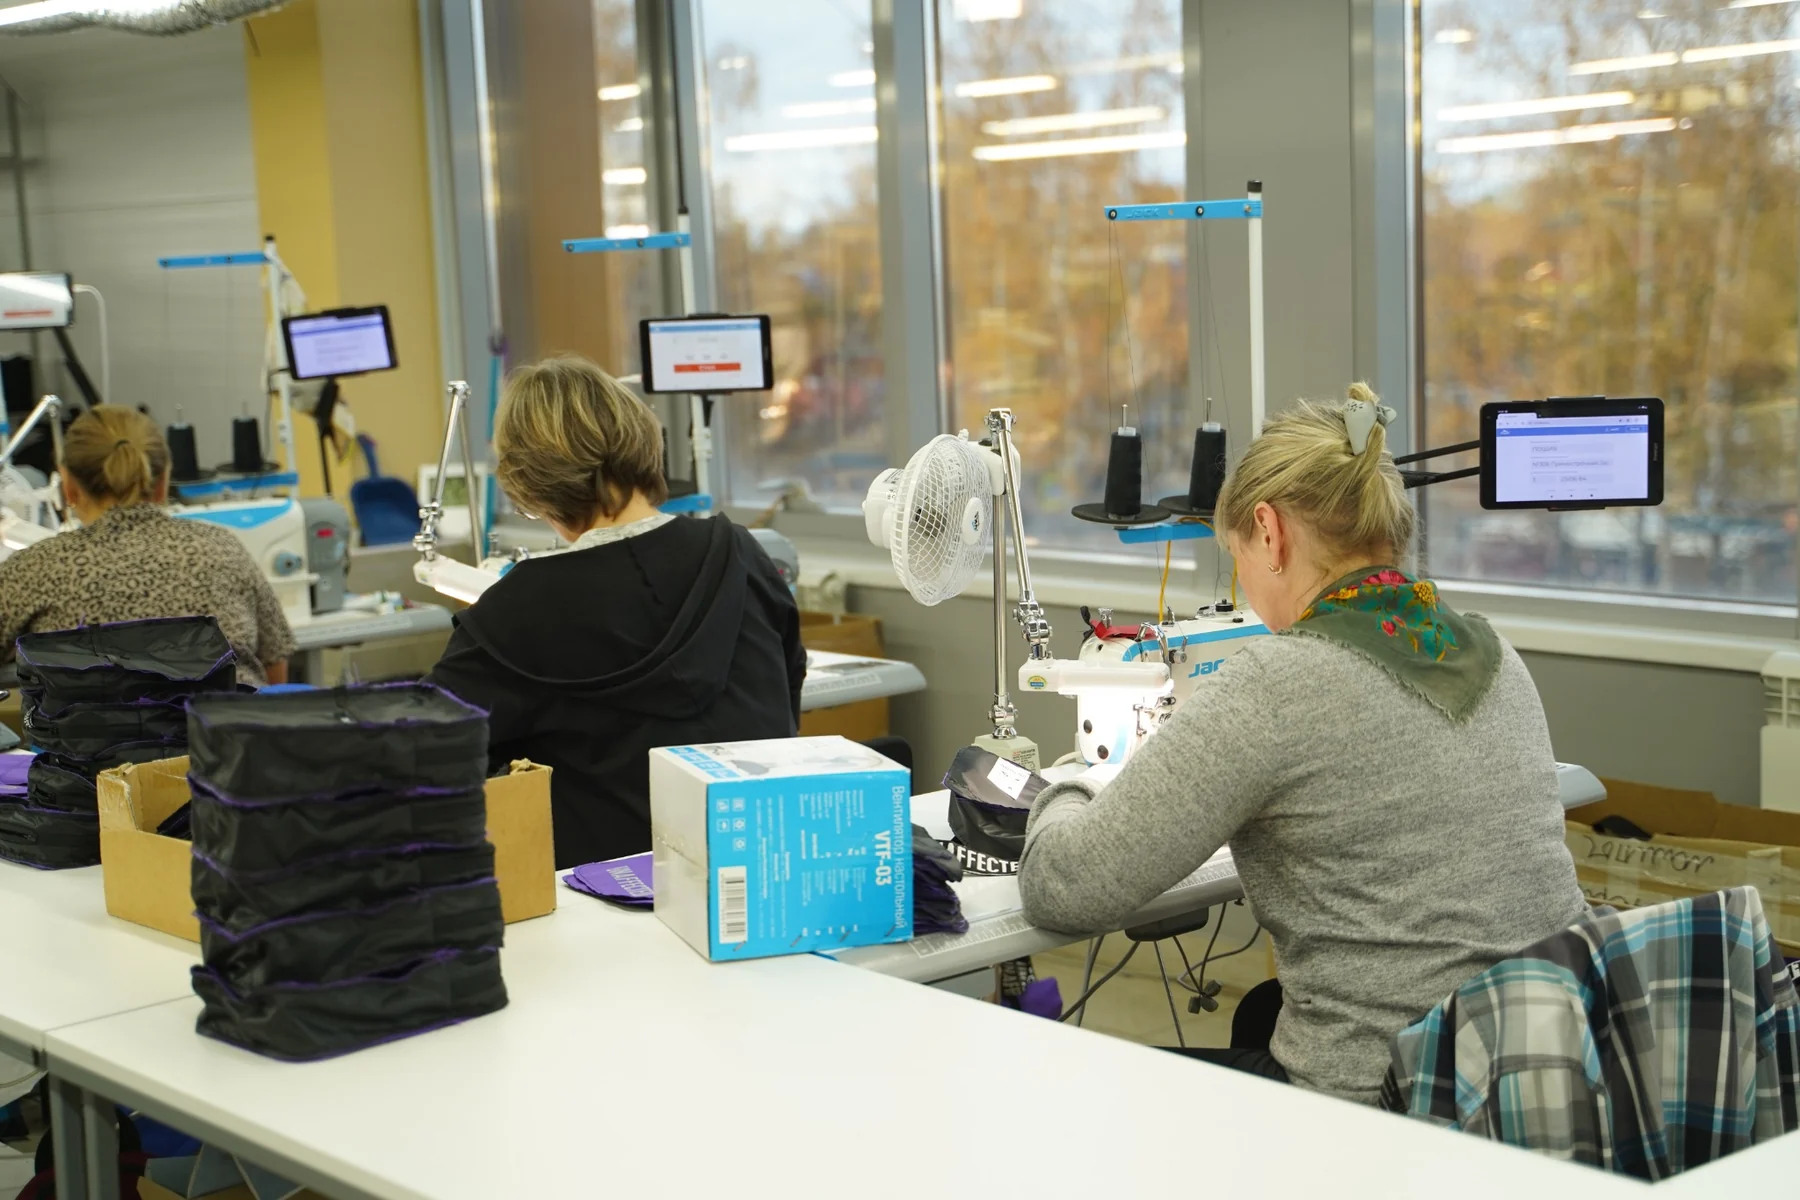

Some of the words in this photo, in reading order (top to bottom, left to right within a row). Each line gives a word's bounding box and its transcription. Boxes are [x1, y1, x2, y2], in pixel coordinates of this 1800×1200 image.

[890, 785, 906, 855] Вентилятор
[875, 830, 892, 886] VTF-03
[893, 858, 908, 929] настольный
